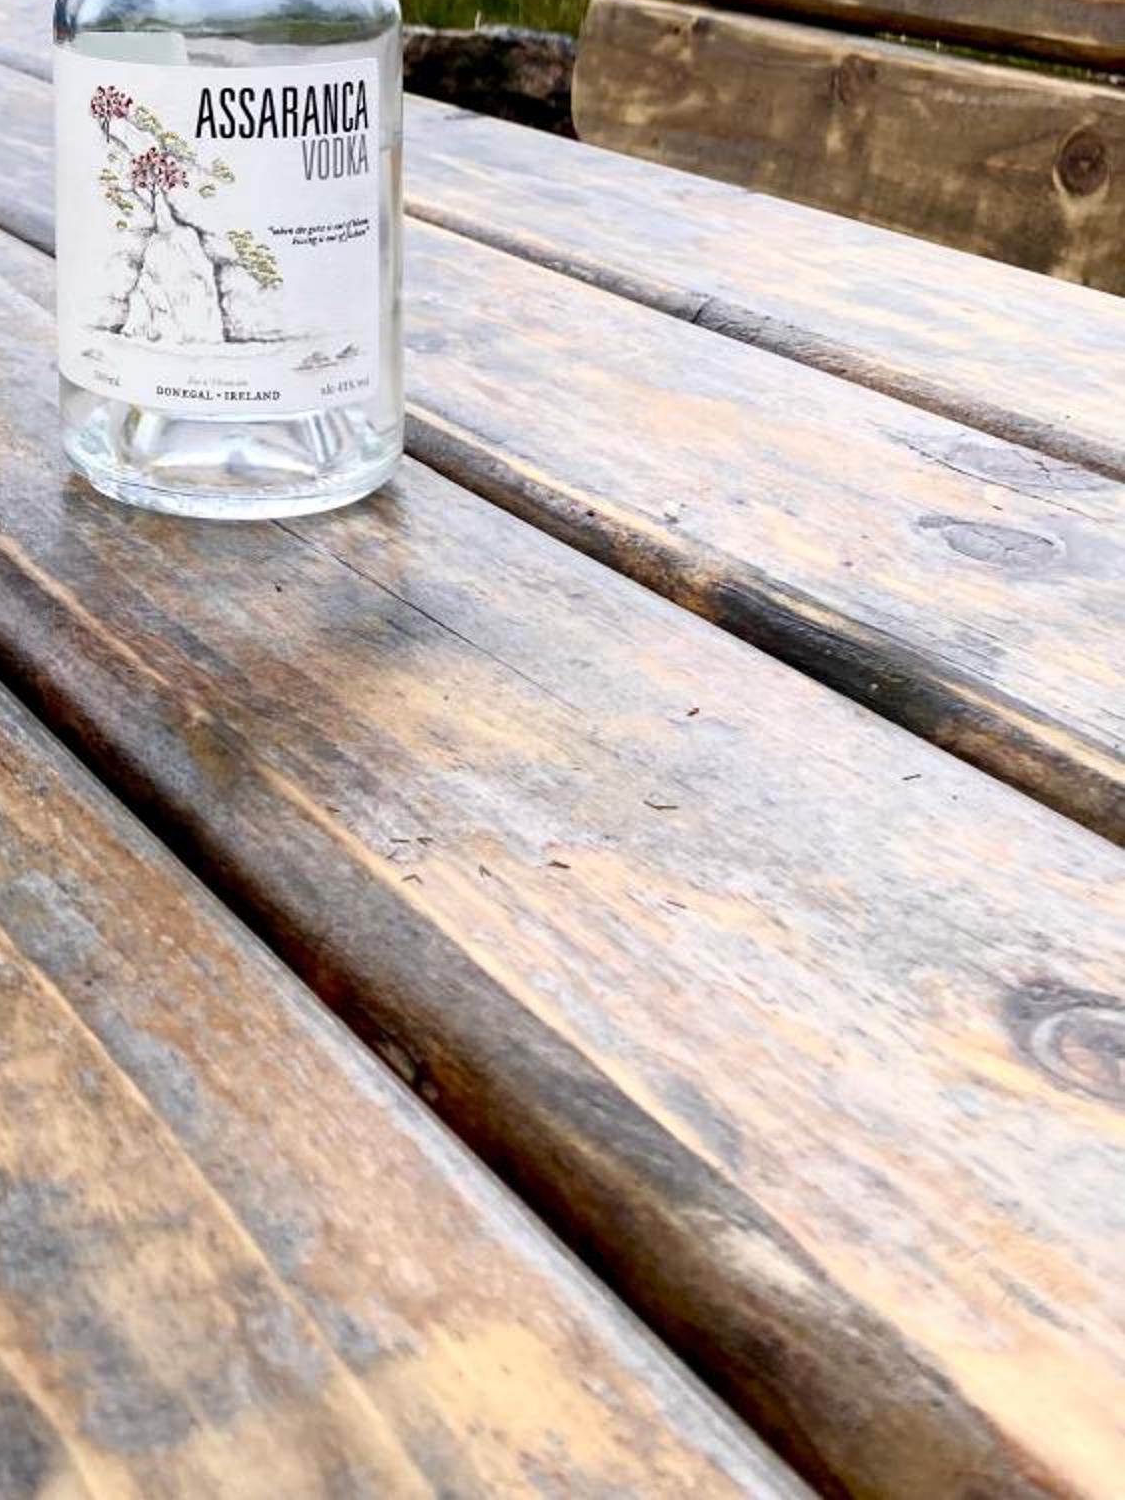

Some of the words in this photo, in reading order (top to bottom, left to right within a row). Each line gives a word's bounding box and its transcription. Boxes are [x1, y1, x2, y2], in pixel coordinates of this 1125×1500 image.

[195, 79, 369, 139] ASSARANCA
[302, 134, 369, 181] VODKA
[156, 385, 214, 401] DONEGAL
[224, 390, 282, 402] IRELAND
